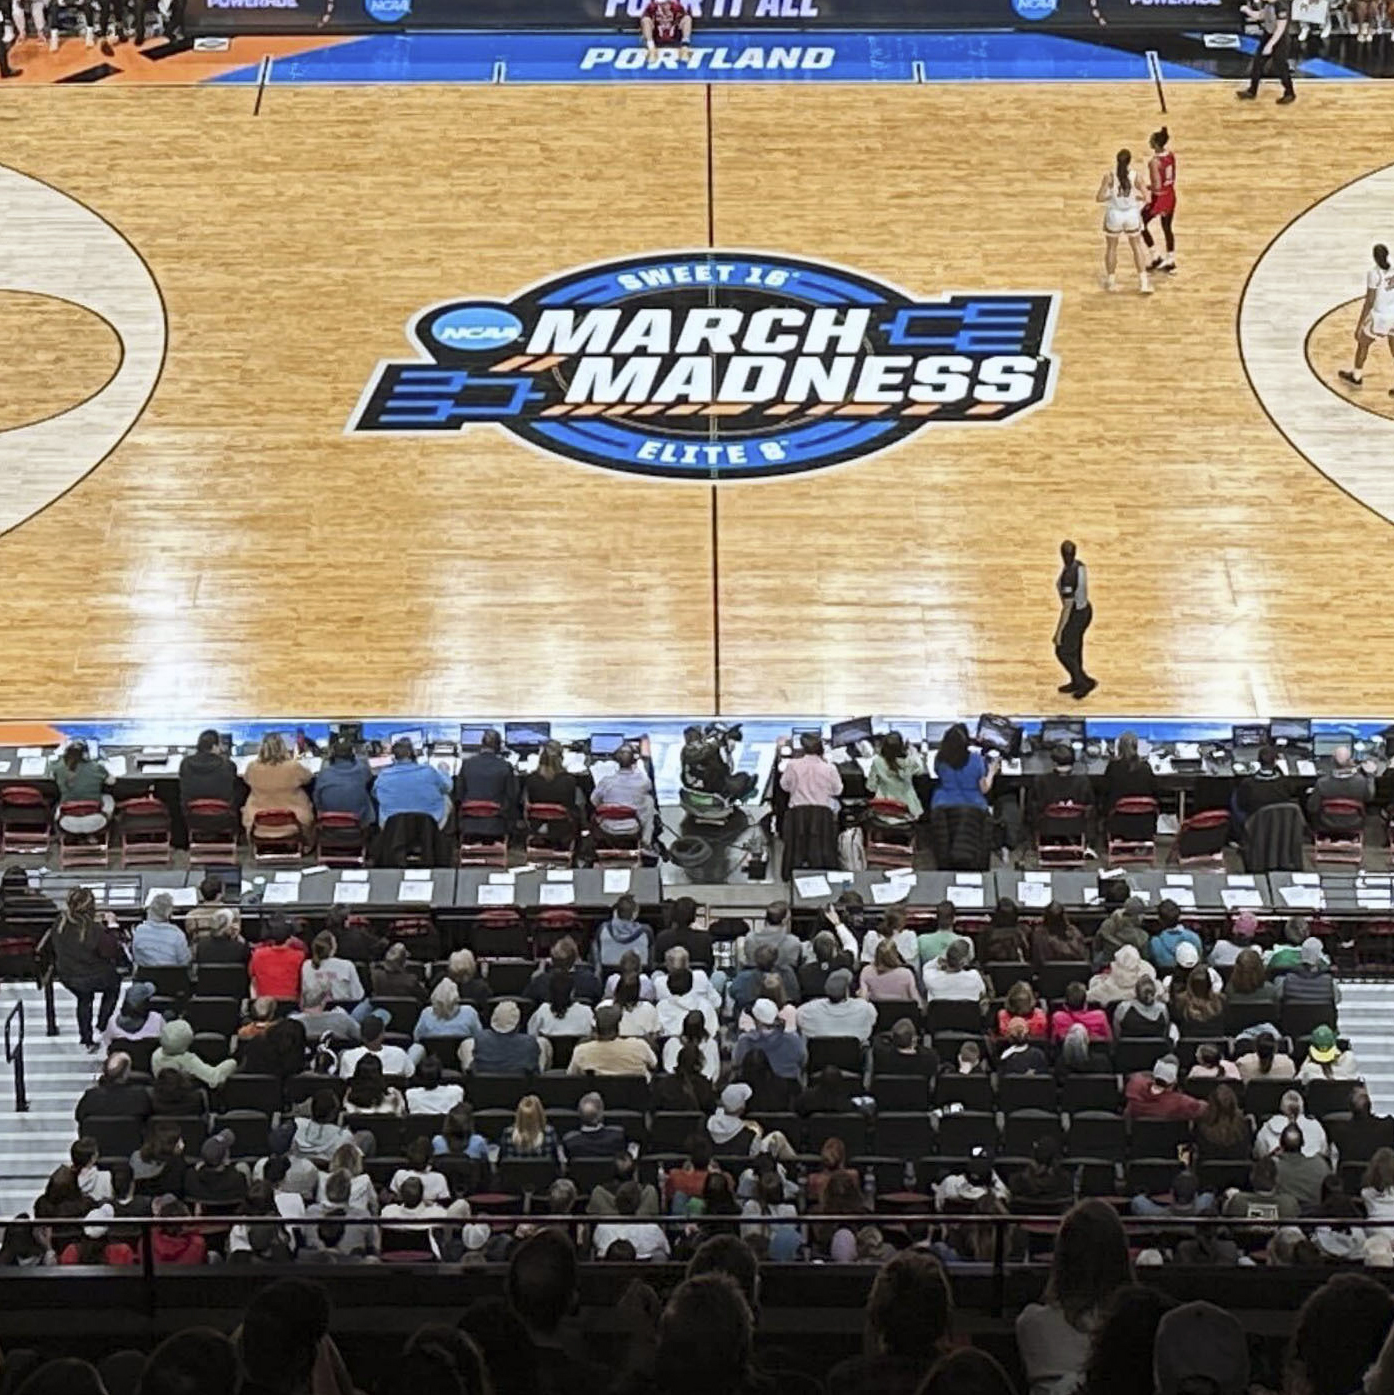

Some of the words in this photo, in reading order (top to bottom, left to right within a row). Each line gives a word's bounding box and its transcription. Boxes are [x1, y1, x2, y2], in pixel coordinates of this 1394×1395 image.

[371, 0, 411, 12] NCAA
[579, 46, 837, 70] PORTLAND
[617, 264, 735, 291] SWEET
[745, 266, 790, 288] 16
[438, 326, 521, 342] NCAA
[525, 308, 872, 354] MARCH
[563, 355, 1042, 404] MADNESS
[636, 439, 748, 465] ELITE
[758, 441, 787, 461] 8
